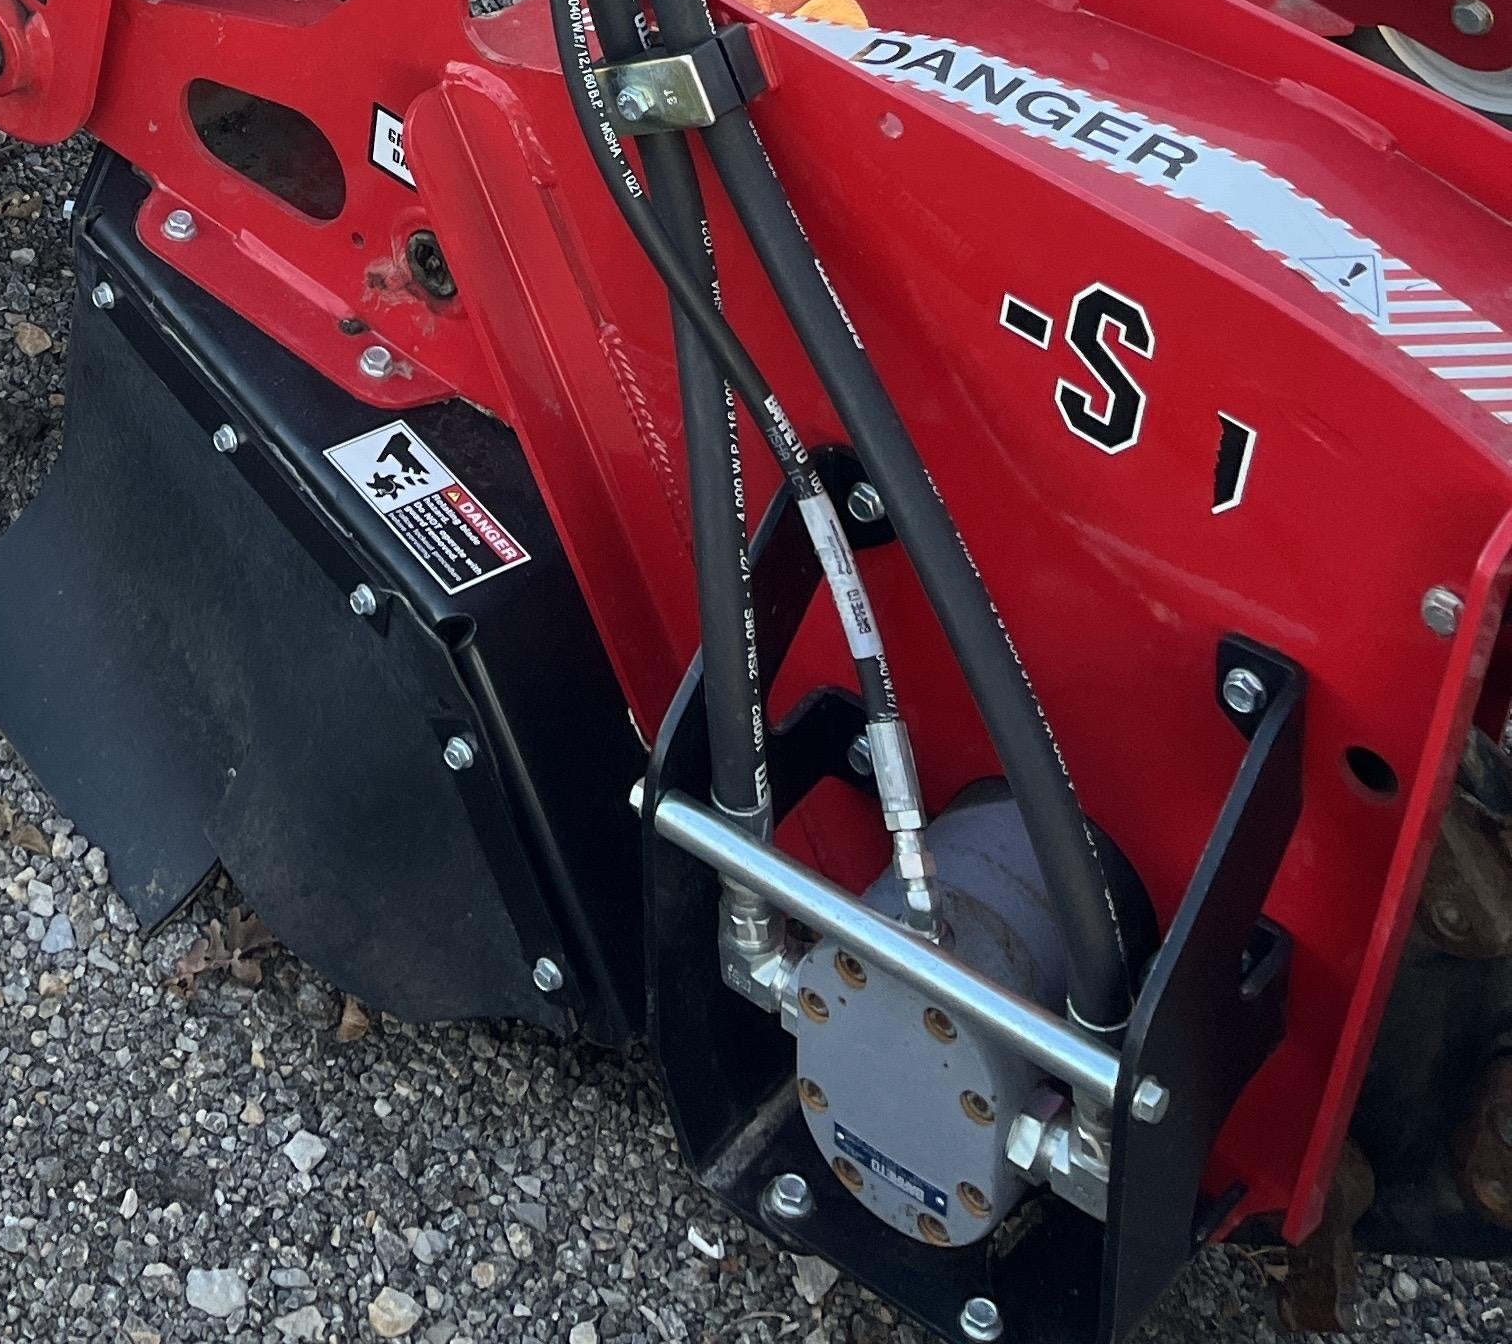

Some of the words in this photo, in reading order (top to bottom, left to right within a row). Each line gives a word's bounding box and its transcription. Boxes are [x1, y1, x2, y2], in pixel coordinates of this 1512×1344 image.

[599, 121, 624, 159] MSHA
[850, 38, 1199, 182] DANGER
[763, 393, 809, 465] BARRETO
[403, 505, 429, 528] guard
[424, 527, 458, 562] removed.
[413, 501, 426, 514] Do
[424, 512, 443, 530] NOT
[438, 528, 467, 559] operate
[465, 557, 483, 576] with
[422, 496, 450, 525] hazard.
[432, 493, 462, 526] Rotating
[459, 523, 482, 546] blade
[458, 500, 518, 561] DANGER
[395, 508, 414, 530] Follow
[432, 550, 463, 582] procedure
